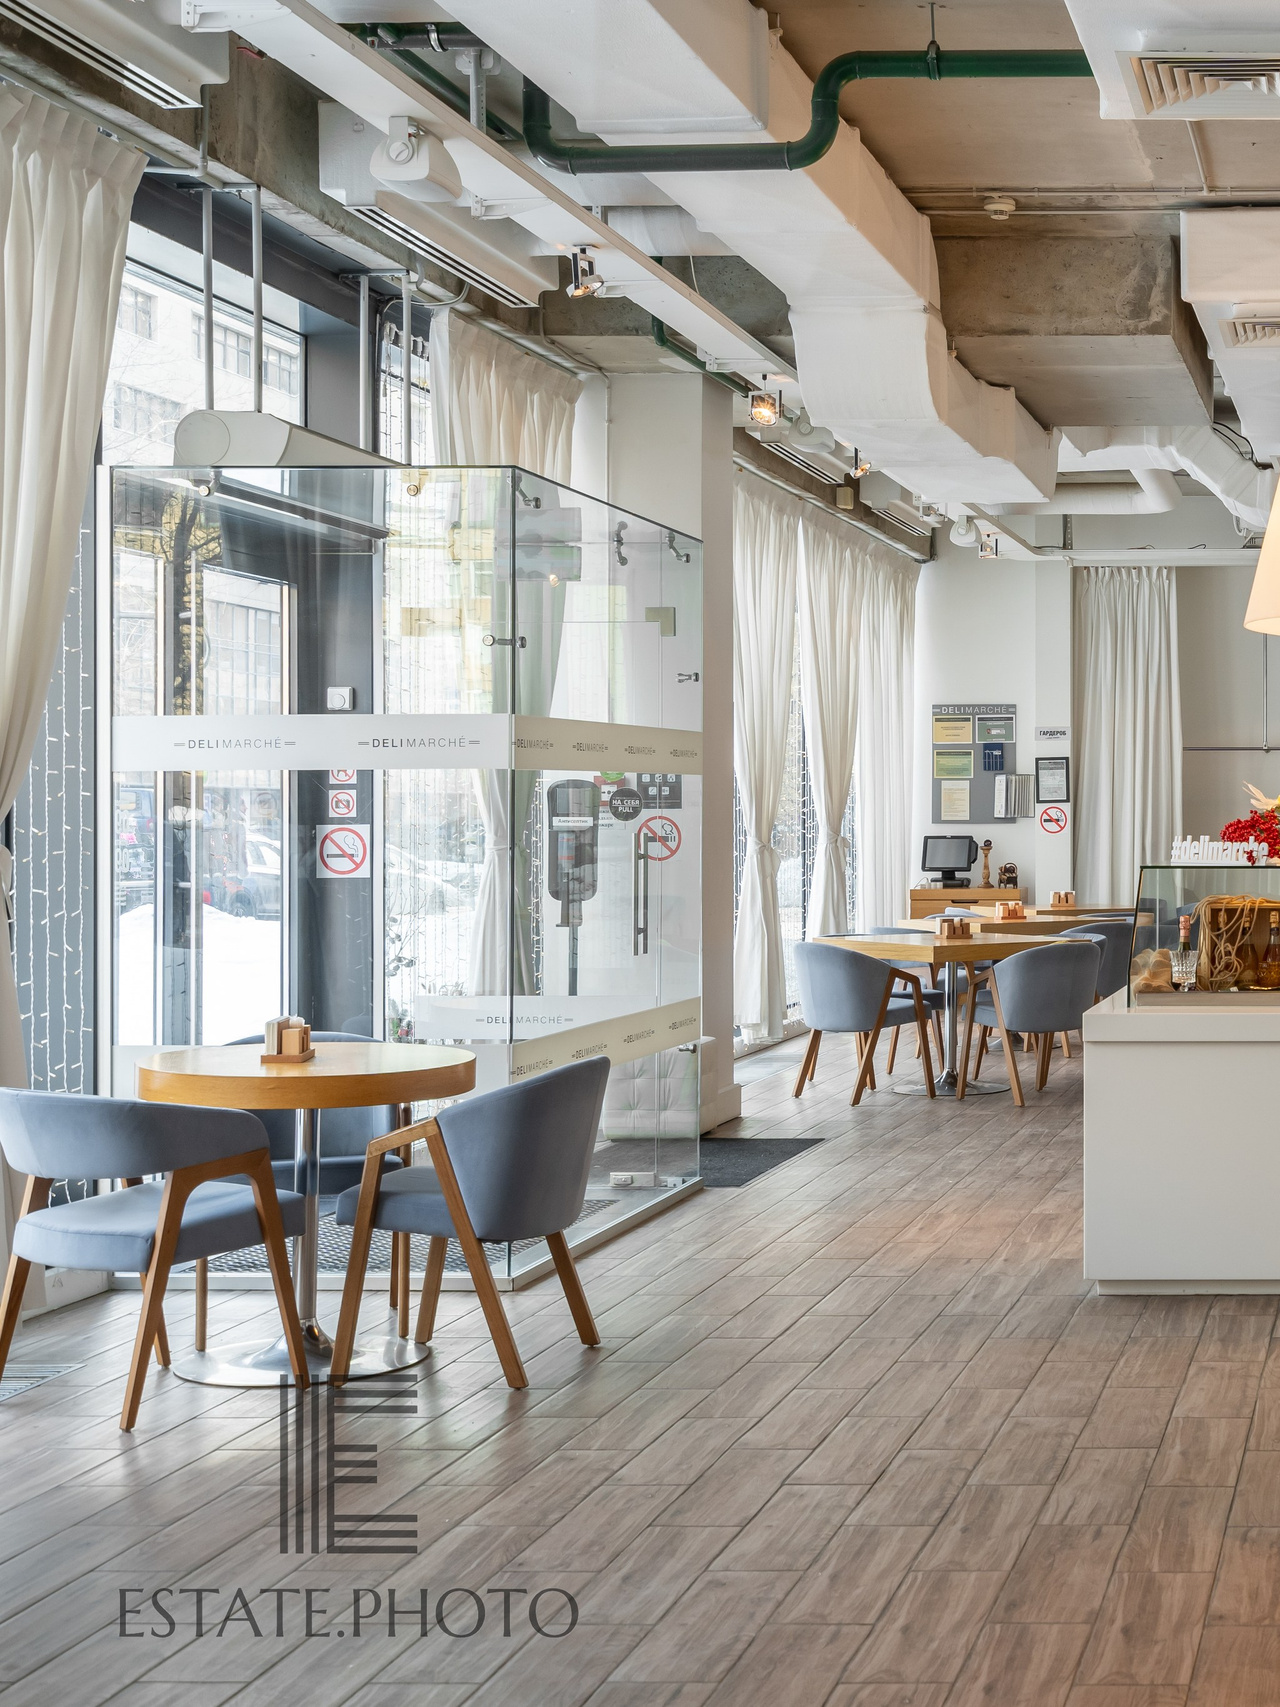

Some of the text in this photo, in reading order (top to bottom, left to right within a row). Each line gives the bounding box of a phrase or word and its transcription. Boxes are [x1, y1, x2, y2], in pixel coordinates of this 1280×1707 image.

[941, 705, 1008, 714] DELIMARCHÉ
[187, 737, 282, 749] DELIMARCHÉ
[372, 736, 467, 748] DELIMARCHÉ
[1171, 835, 1269, 862] #delimarche
